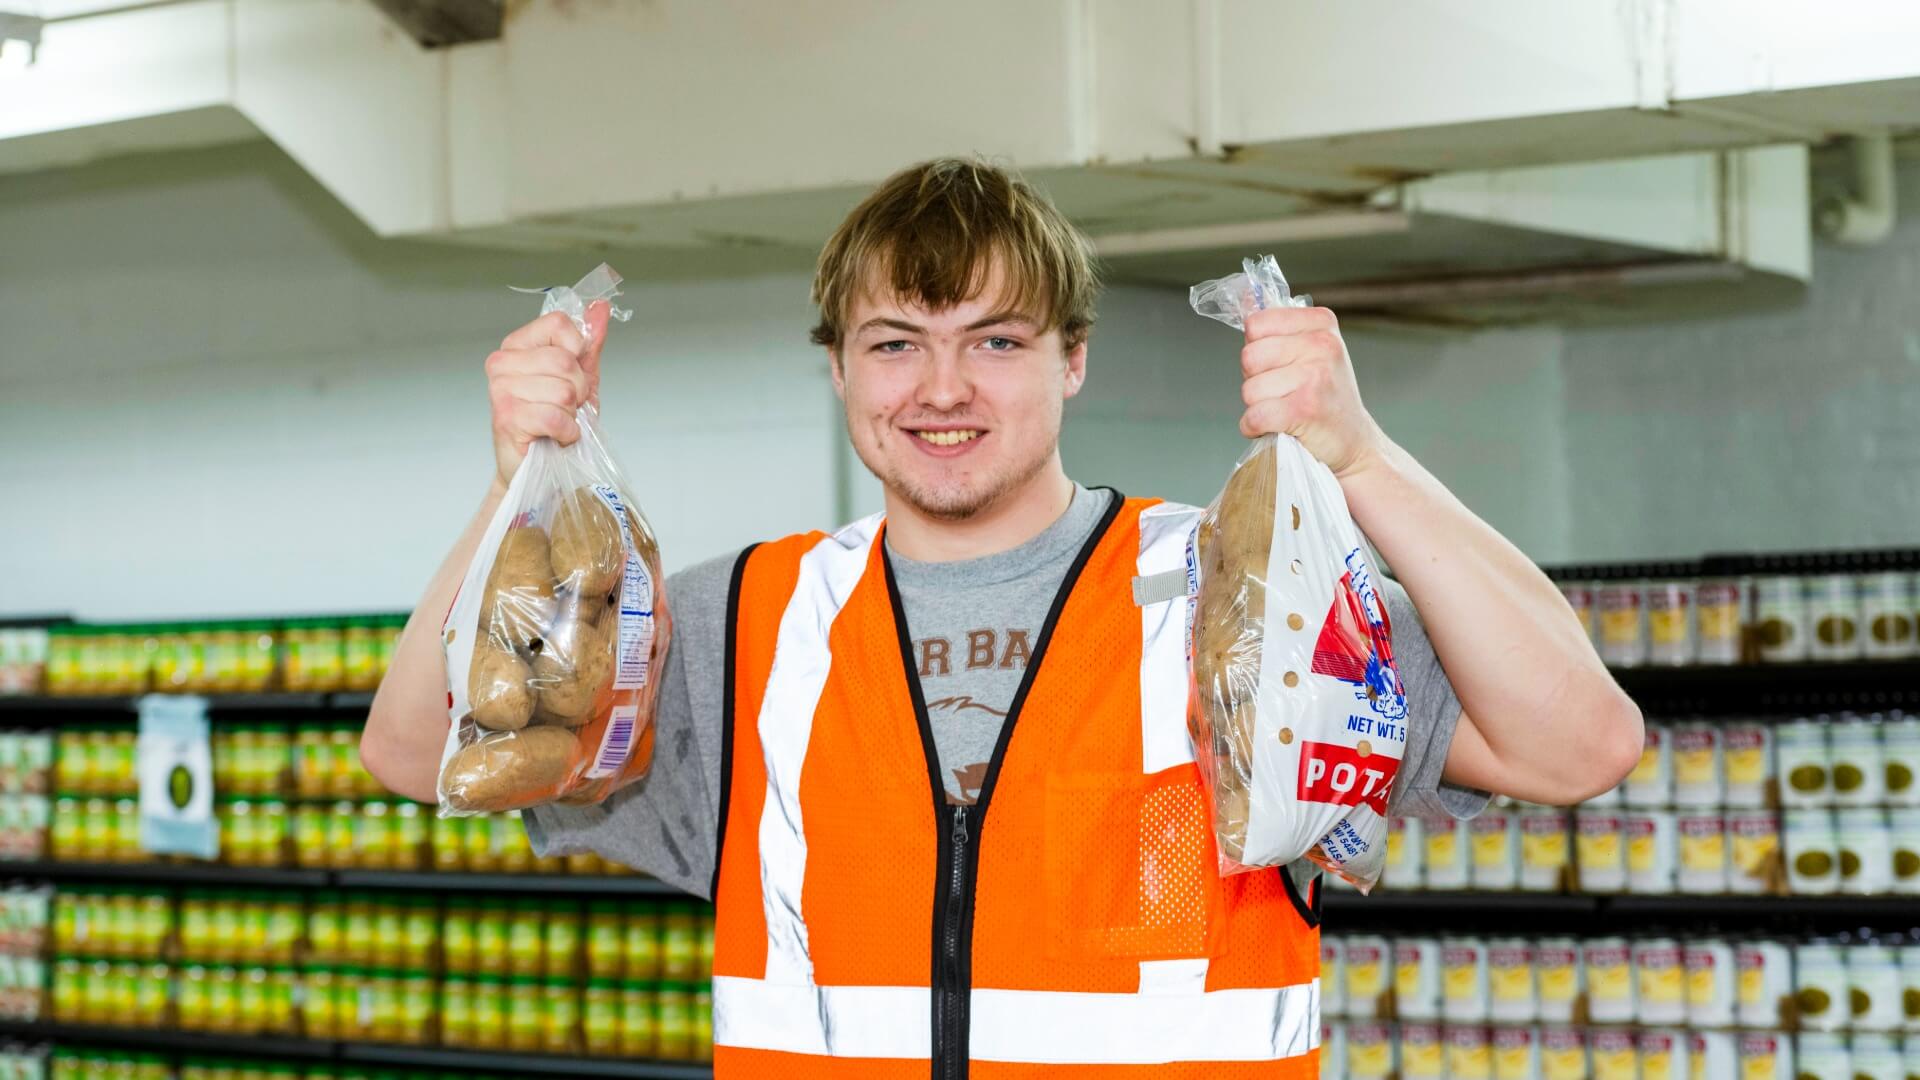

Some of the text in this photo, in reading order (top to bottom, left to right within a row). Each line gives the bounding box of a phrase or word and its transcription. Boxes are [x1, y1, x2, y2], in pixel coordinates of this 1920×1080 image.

[914, 636, 952, 679] R
[1347, 715, 1405, 742] NET WT. 5
